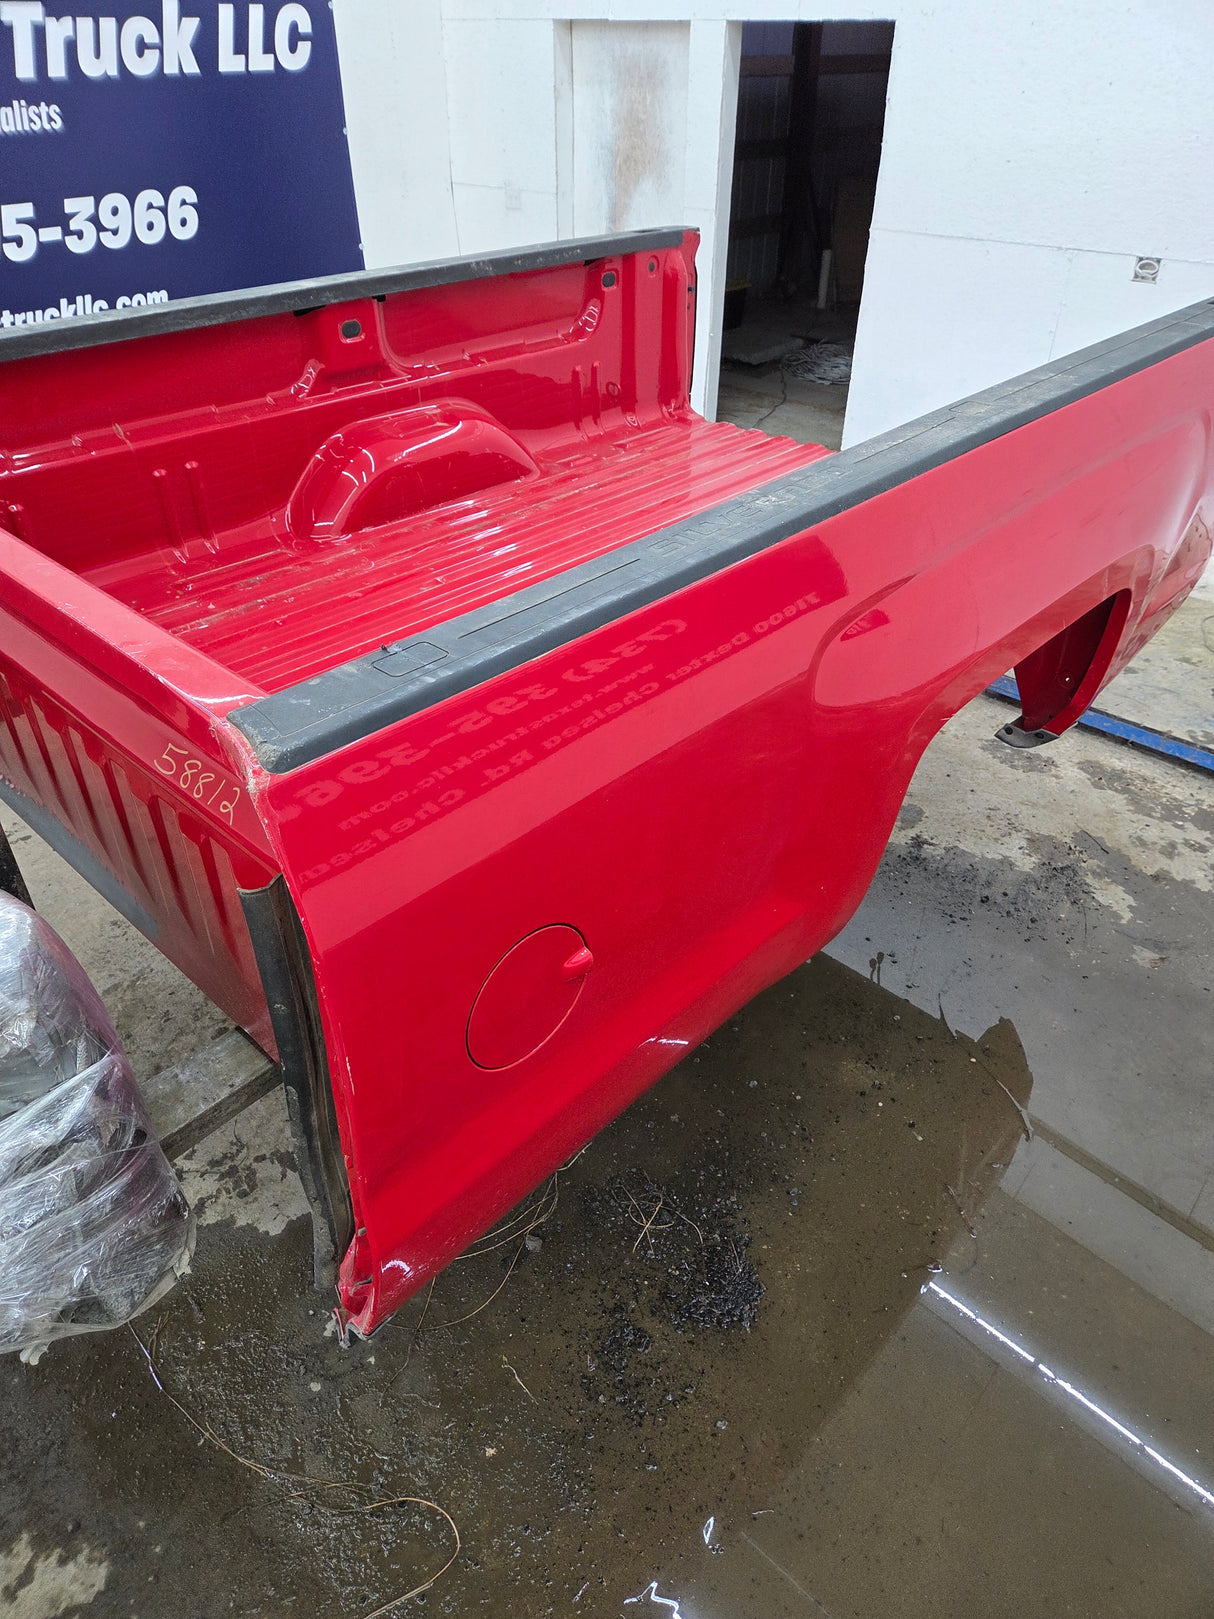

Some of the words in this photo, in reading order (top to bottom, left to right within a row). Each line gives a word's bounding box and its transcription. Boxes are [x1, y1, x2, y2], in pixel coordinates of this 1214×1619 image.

[0, 0, 199, 80] Truck
[218, 3, 312, 72] LLC
[0, 99, 63, 130] alists
[1, 185, 199, 262] 5-3966
[0, 289, 169, 328] truckllccom
[153, 742, 241, 827] 58812
